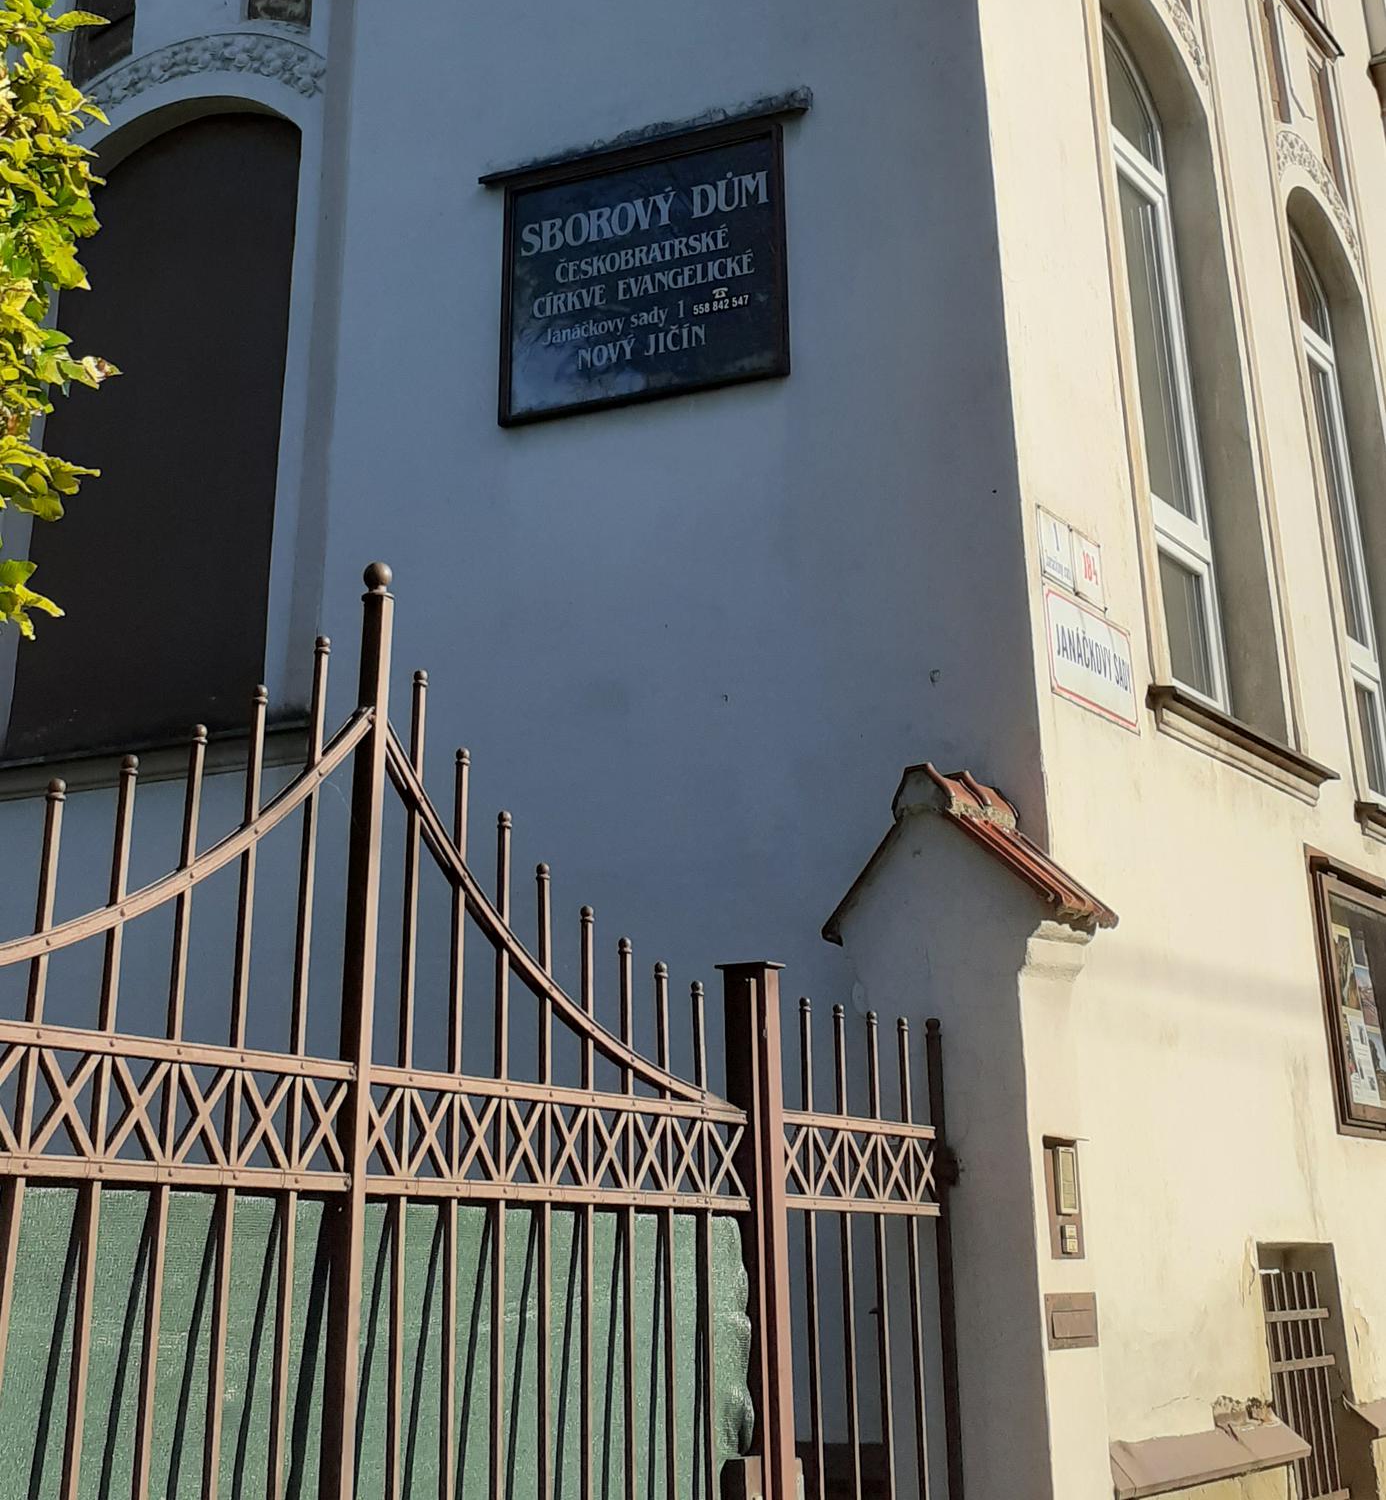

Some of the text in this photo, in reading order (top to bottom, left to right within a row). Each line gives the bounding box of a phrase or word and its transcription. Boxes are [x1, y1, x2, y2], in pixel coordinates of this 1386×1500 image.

[520, 170, 769, 256] SBOROVÝ DŮM
[555, 224, 729, 283] ČESKOBRATRSKÉ
[532, 249, 754, 319] CÍRKVE EVANGELICKÉ
[693, 294, 749, 315] 558 842 547
[542, 300, 685, 345] Janáčkovy sady 1
[577, 323, 707, 371] NOVÝ JIČÍN
[1055, 623, 1132, 694] JANÁČKOVY SADY
